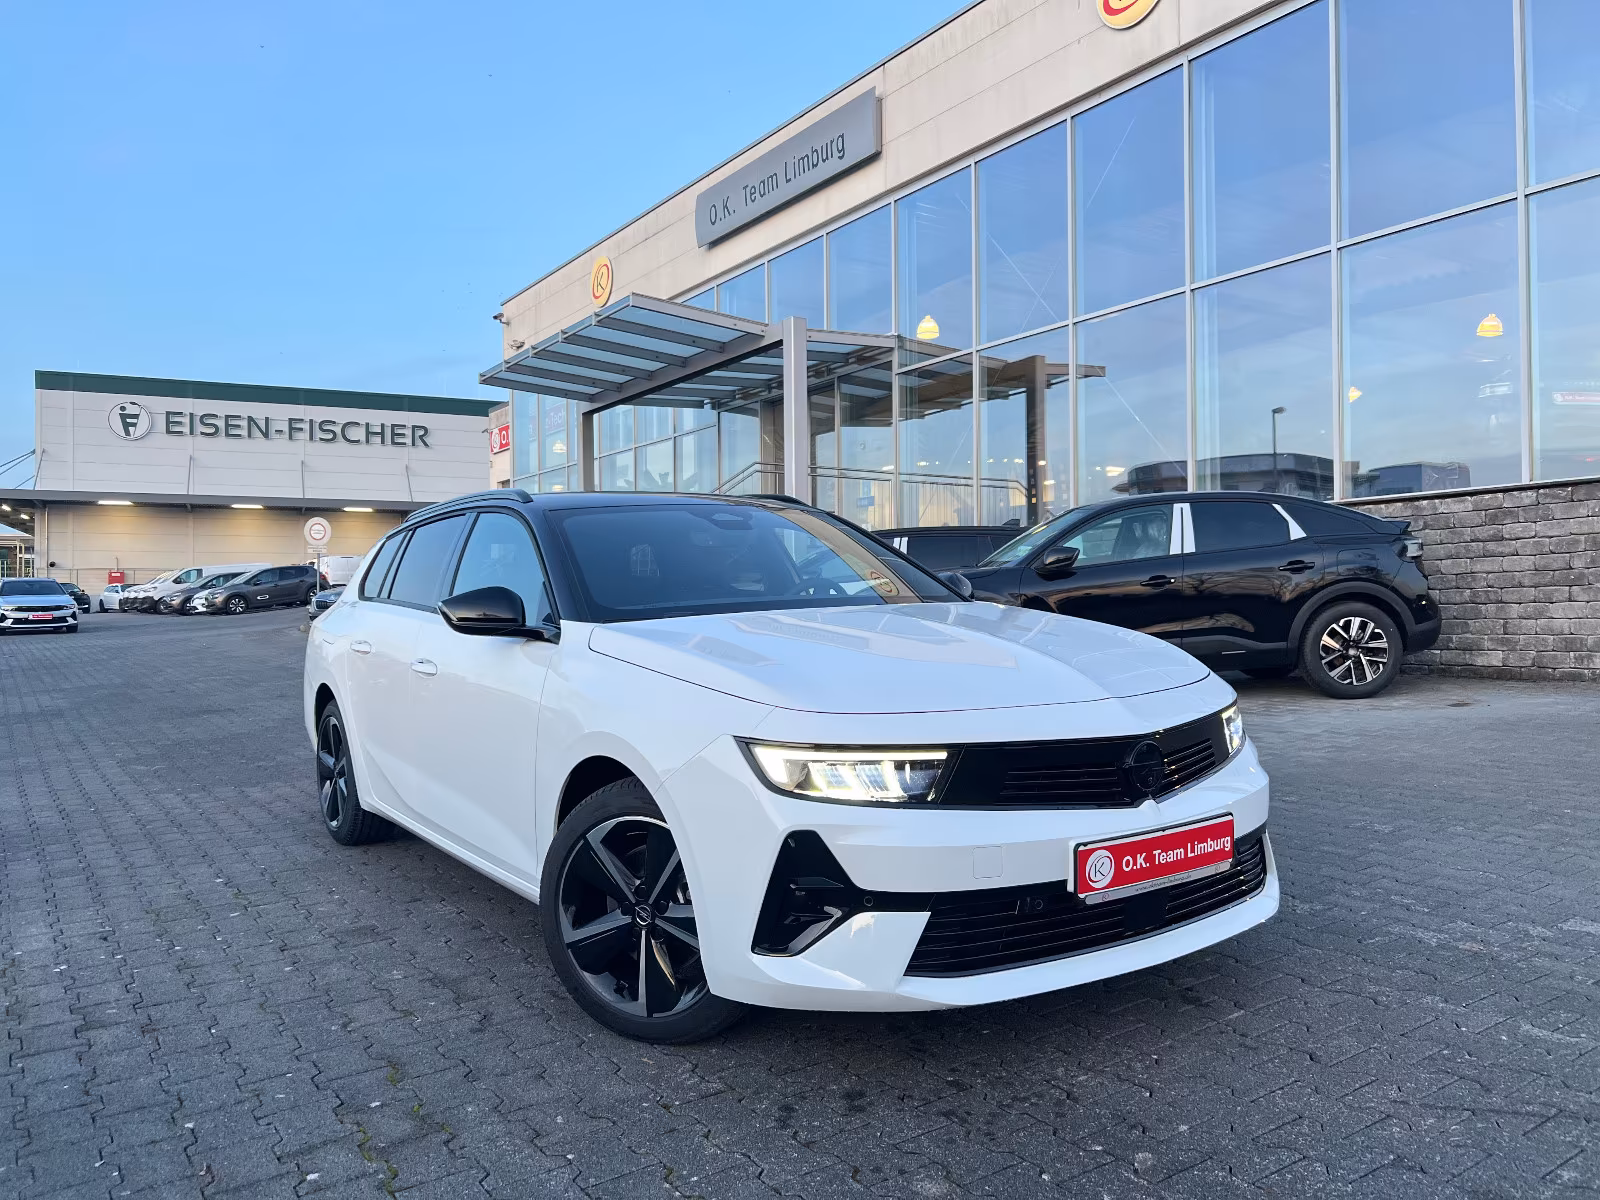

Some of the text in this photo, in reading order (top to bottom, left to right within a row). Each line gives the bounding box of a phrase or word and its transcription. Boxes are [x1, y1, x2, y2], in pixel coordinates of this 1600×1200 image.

[709, 132, 846, 226] O.K. Team Limburg
[164, 410, 430, 448] EISEN-FISCHER
[1122, 852, 1150, 872] O.K.
[1153, 847, 1185, 865] Team
[1187, 835, 1231, 858] Limburg
